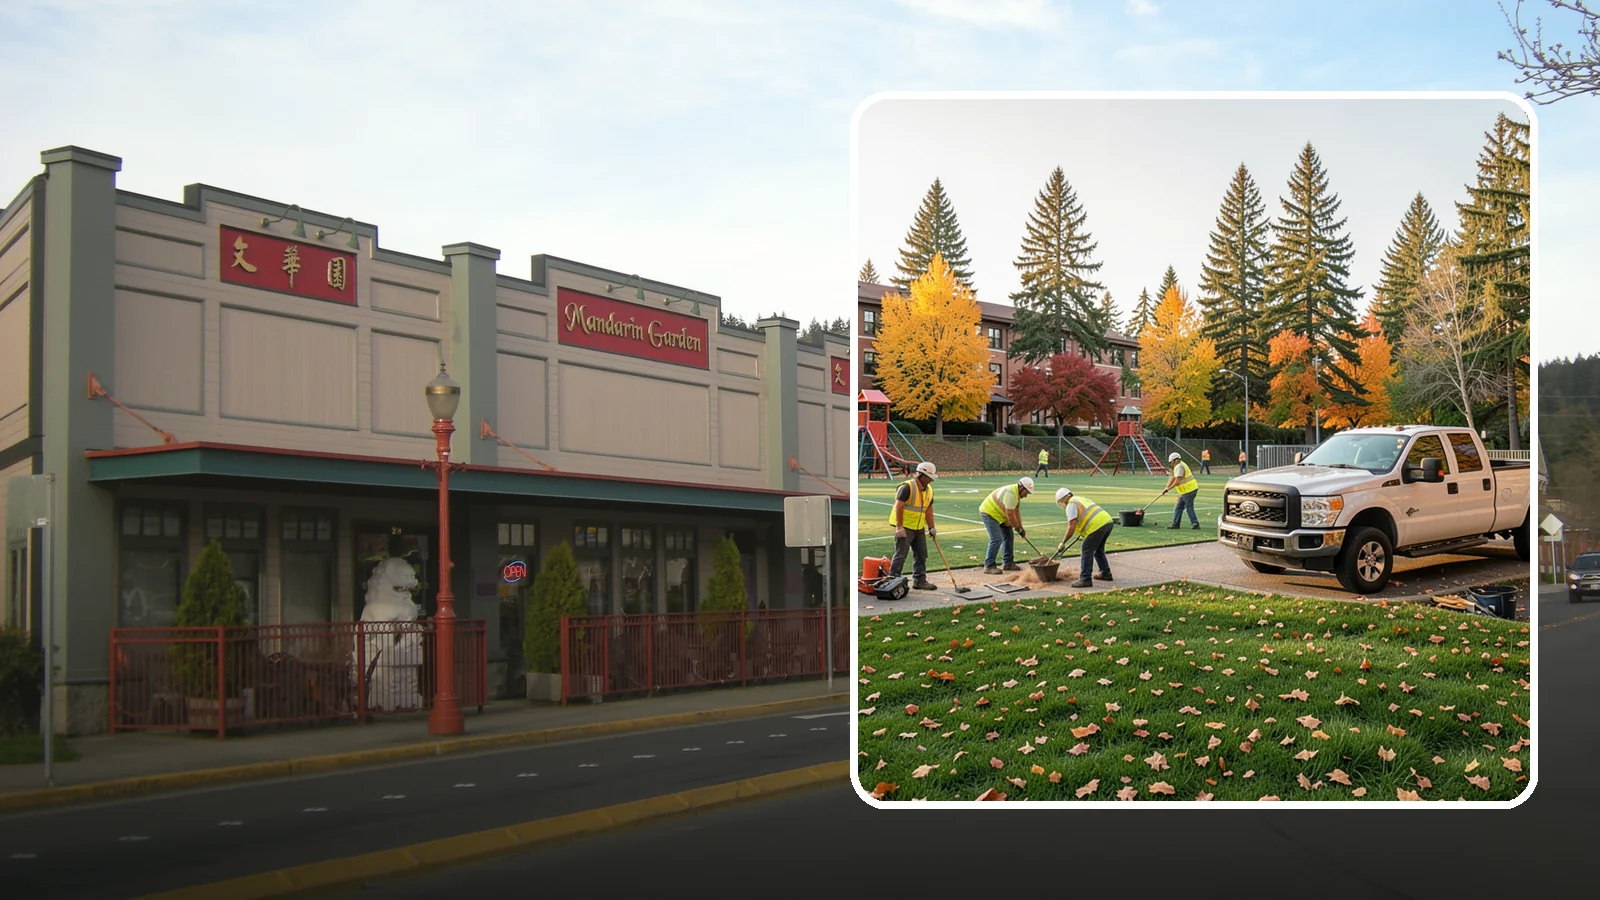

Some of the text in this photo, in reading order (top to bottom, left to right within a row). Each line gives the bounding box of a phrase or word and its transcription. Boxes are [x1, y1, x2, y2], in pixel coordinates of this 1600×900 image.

[231, 236, 346, 291] 文華園
[564, 302, 701, 352] Mandarin Garden
[503, 565, 527, 578] OPEN
